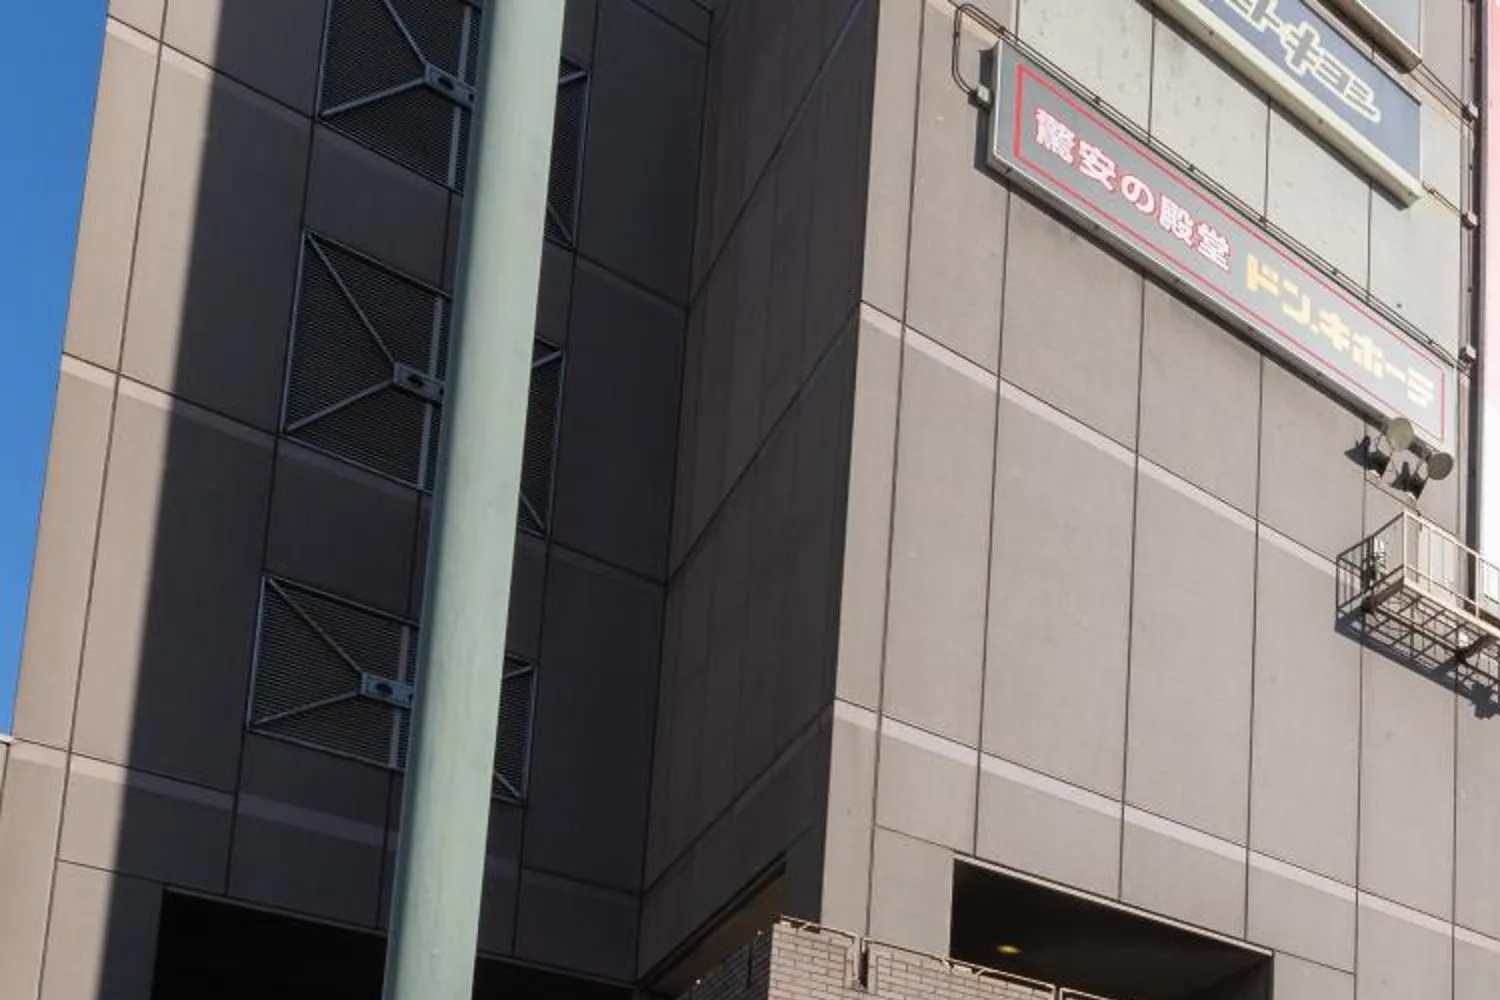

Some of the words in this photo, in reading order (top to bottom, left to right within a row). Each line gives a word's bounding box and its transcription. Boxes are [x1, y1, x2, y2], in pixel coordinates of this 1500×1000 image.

[1034, 107, 1233, 272] 驚安の殿堂
